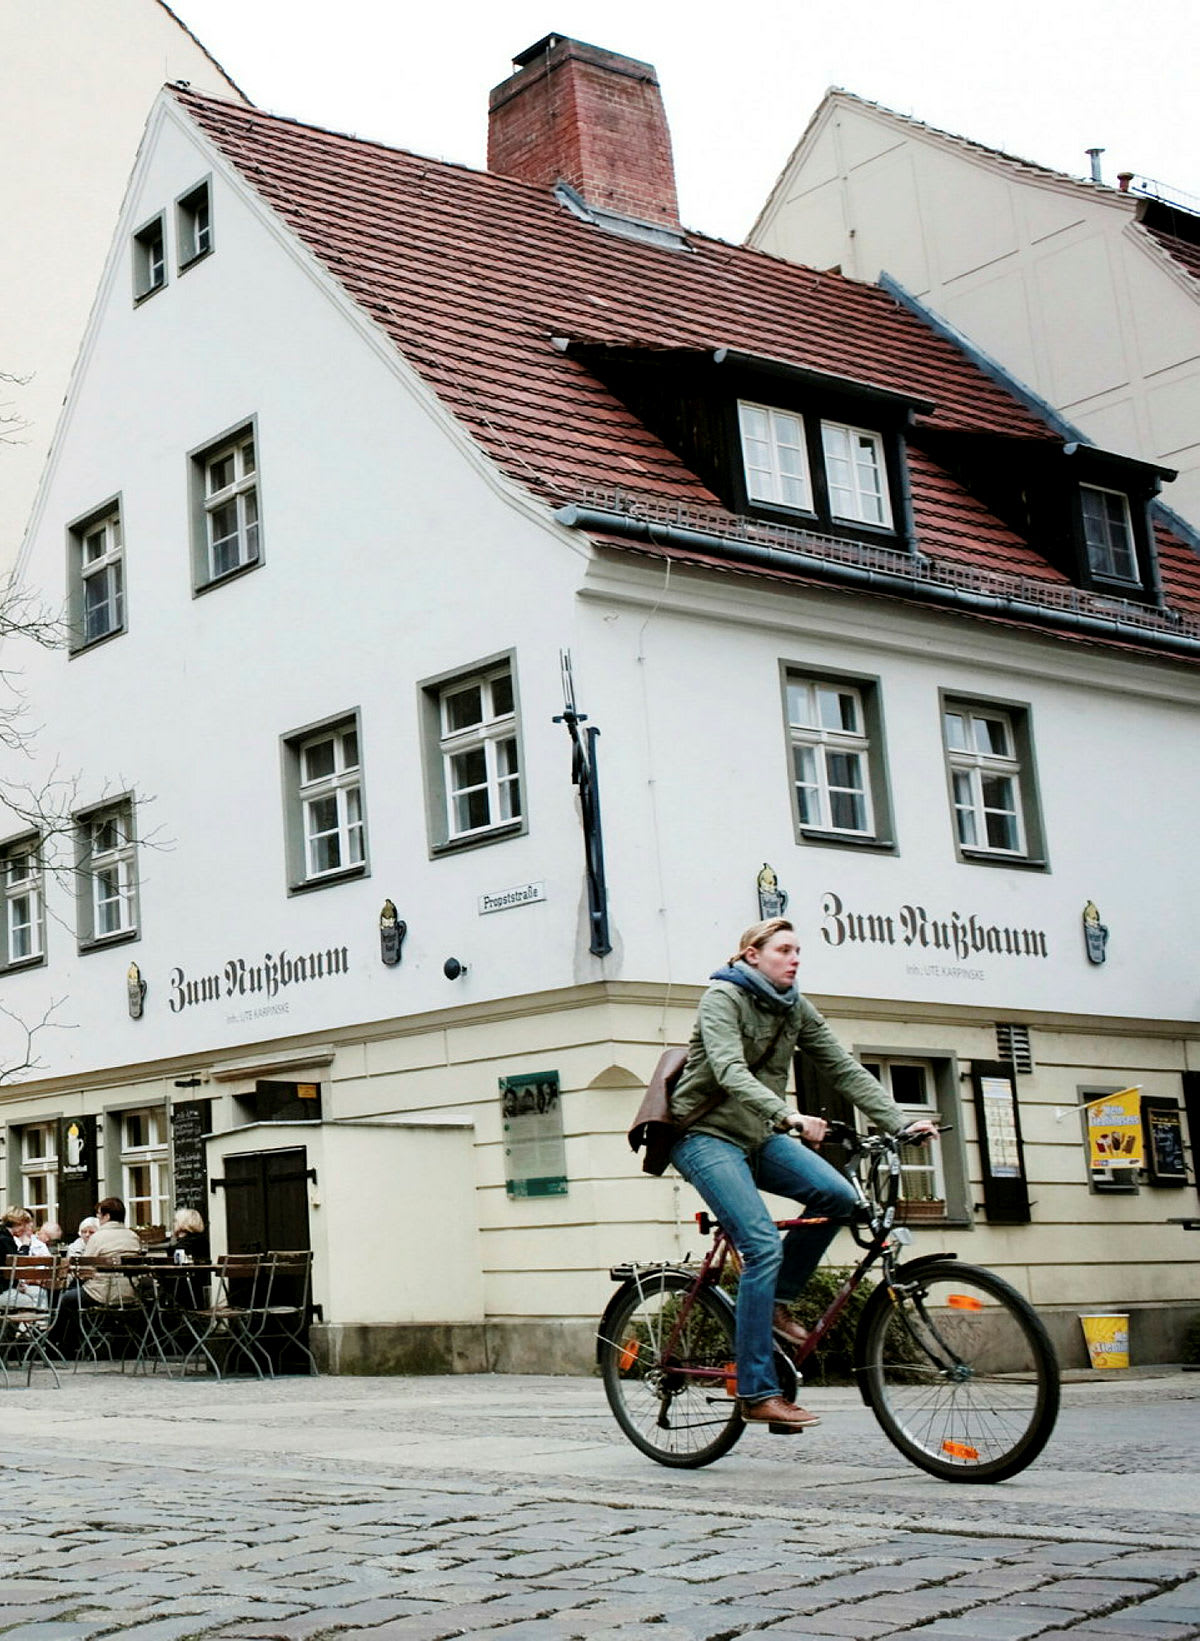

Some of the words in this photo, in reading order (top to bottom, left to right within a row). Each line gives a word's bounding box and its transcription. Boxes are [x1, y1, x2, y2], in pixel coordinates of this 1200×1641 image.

[484, 885, 538, 909] Propststraße
[821, 892, 896, 946] Zum
[900, 905, 1048, 961] Nußbaum
[169, 967, 221, 1013] Zum
[224, 946, 349, 999] Nußbaum
